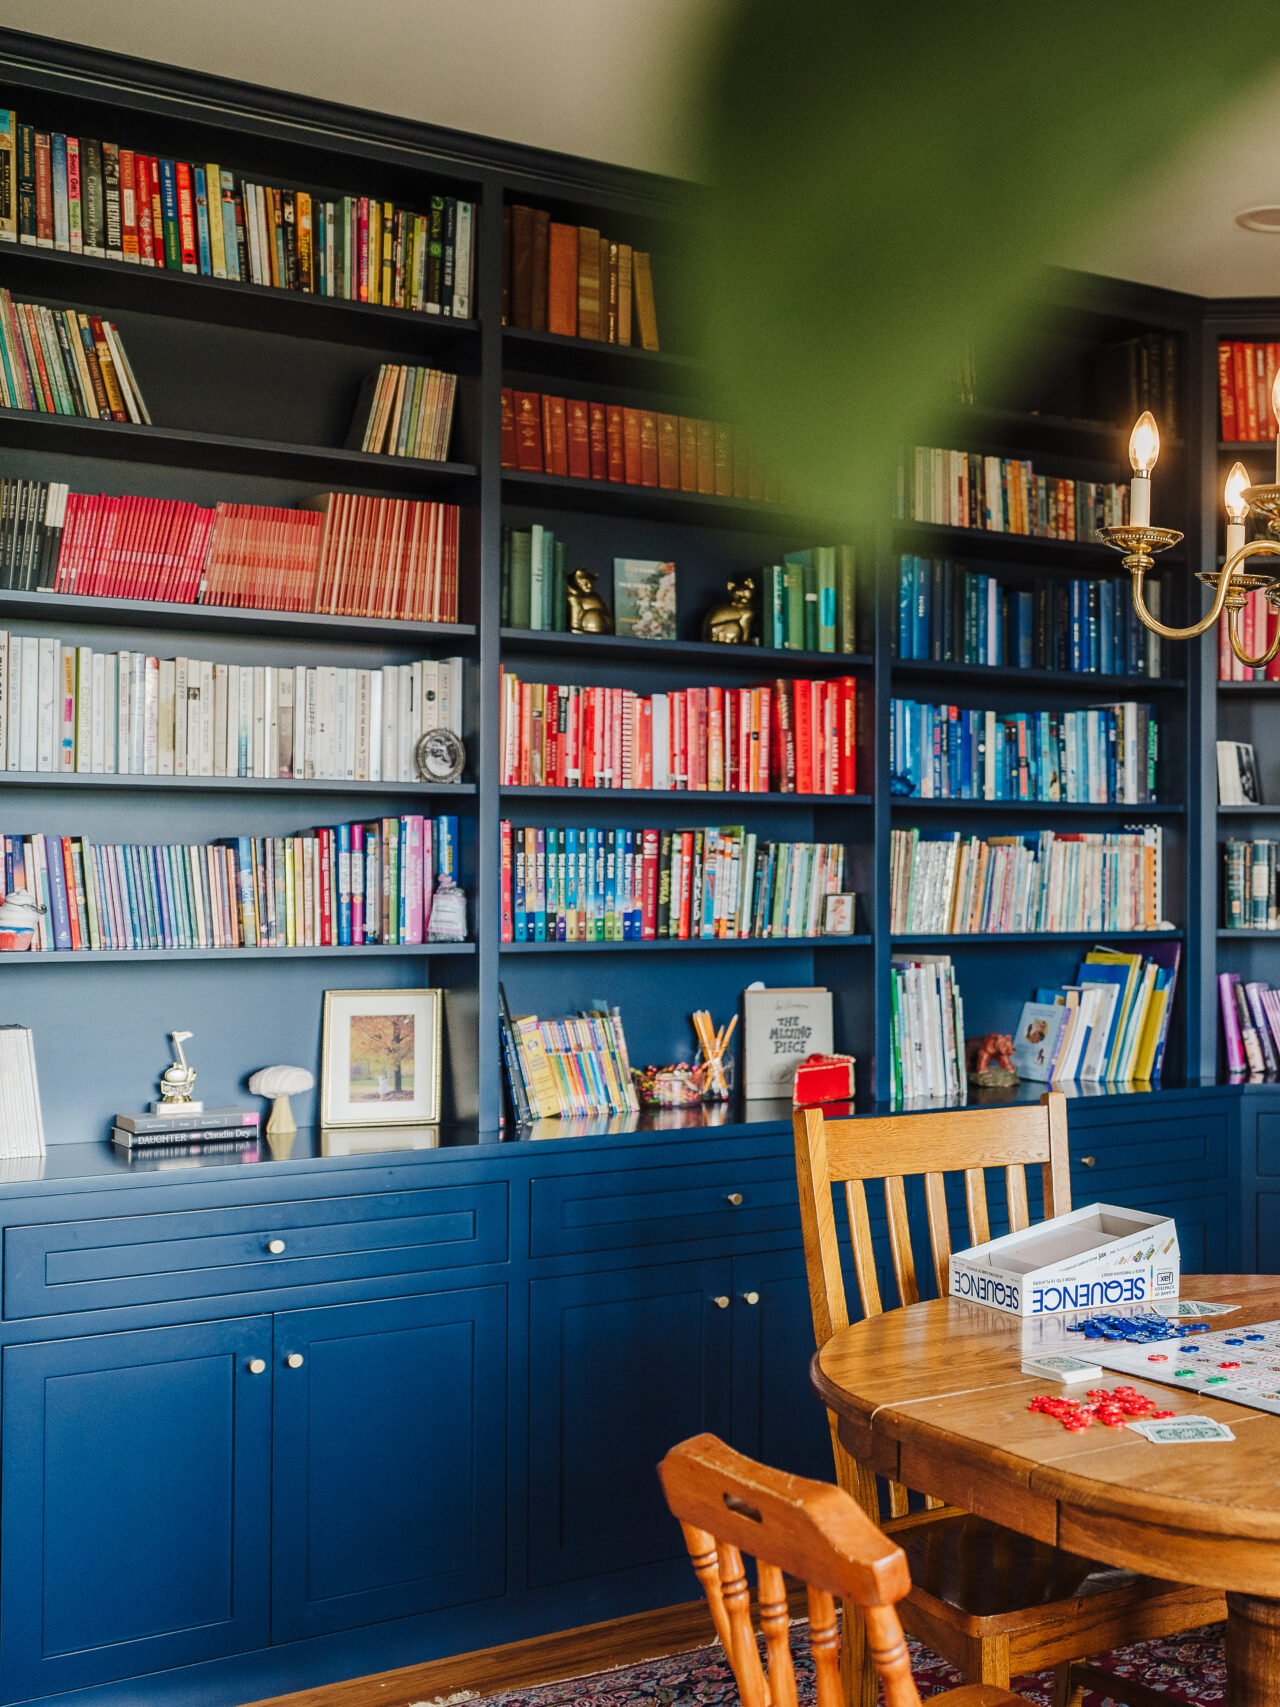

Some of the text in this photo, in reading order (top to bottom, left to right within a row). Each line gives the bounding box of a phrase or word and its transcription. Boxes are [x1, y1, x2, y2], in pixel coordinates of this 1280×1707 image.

[180, 190, 192, 250] VIRTUAL SABOTAGE
[80, 687, 90, 757] Elizabeth Strout
[769, 1026, 812, 1040] MISSING
[777, 1016, 800, 1027] THE
[774, 1041, 806, 1054] PIECE
[138, 1128, 250, 1144] DAUGHTER Claudia Dey
[954, 1270, 1020, 1310] SEQUENCE
[1032, 1276, 1146, 1314] SEQUENCE
